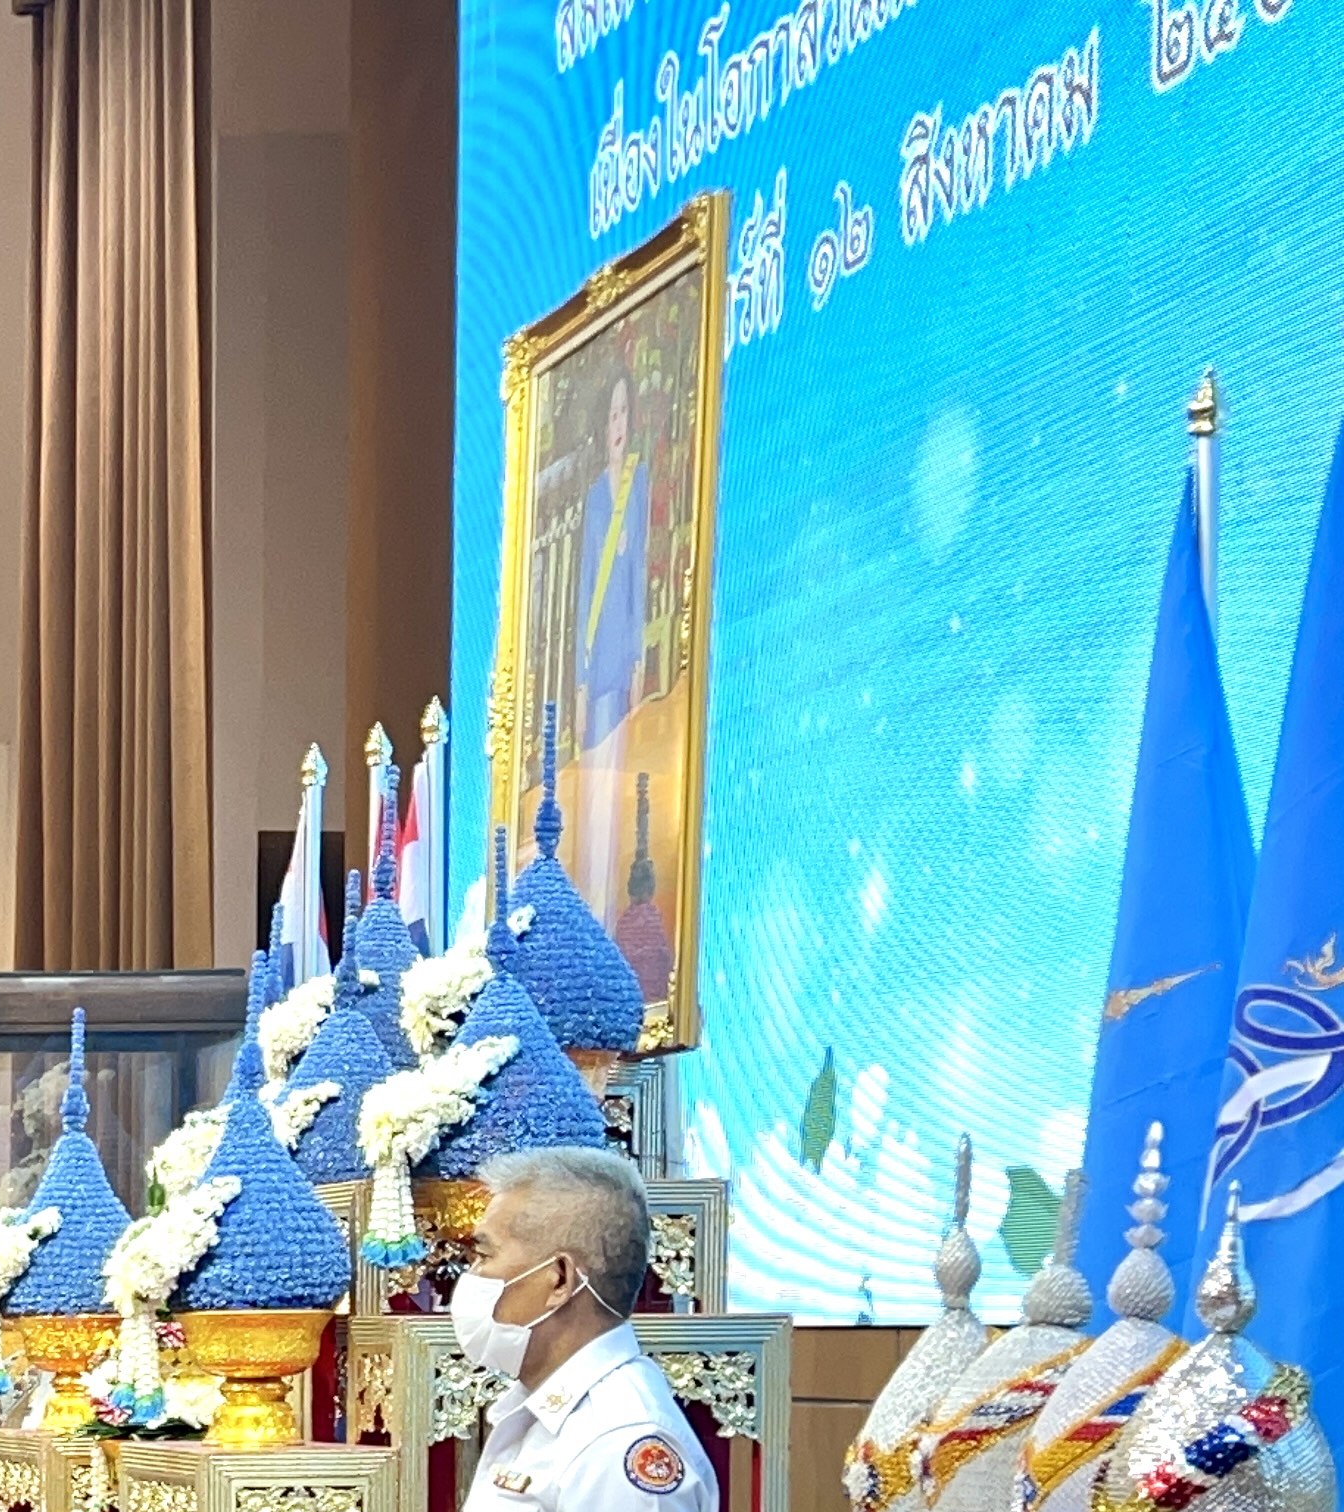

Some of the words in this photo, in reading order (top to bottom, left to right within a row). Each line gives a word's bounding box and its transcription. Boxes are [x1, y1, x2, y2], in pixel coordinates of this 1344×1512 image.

[809, 180, 874, 312] ๑๒
[900, 22, 1100, 246] สิงหาคม
[1152, 0, 1294, 94] ๒๕
